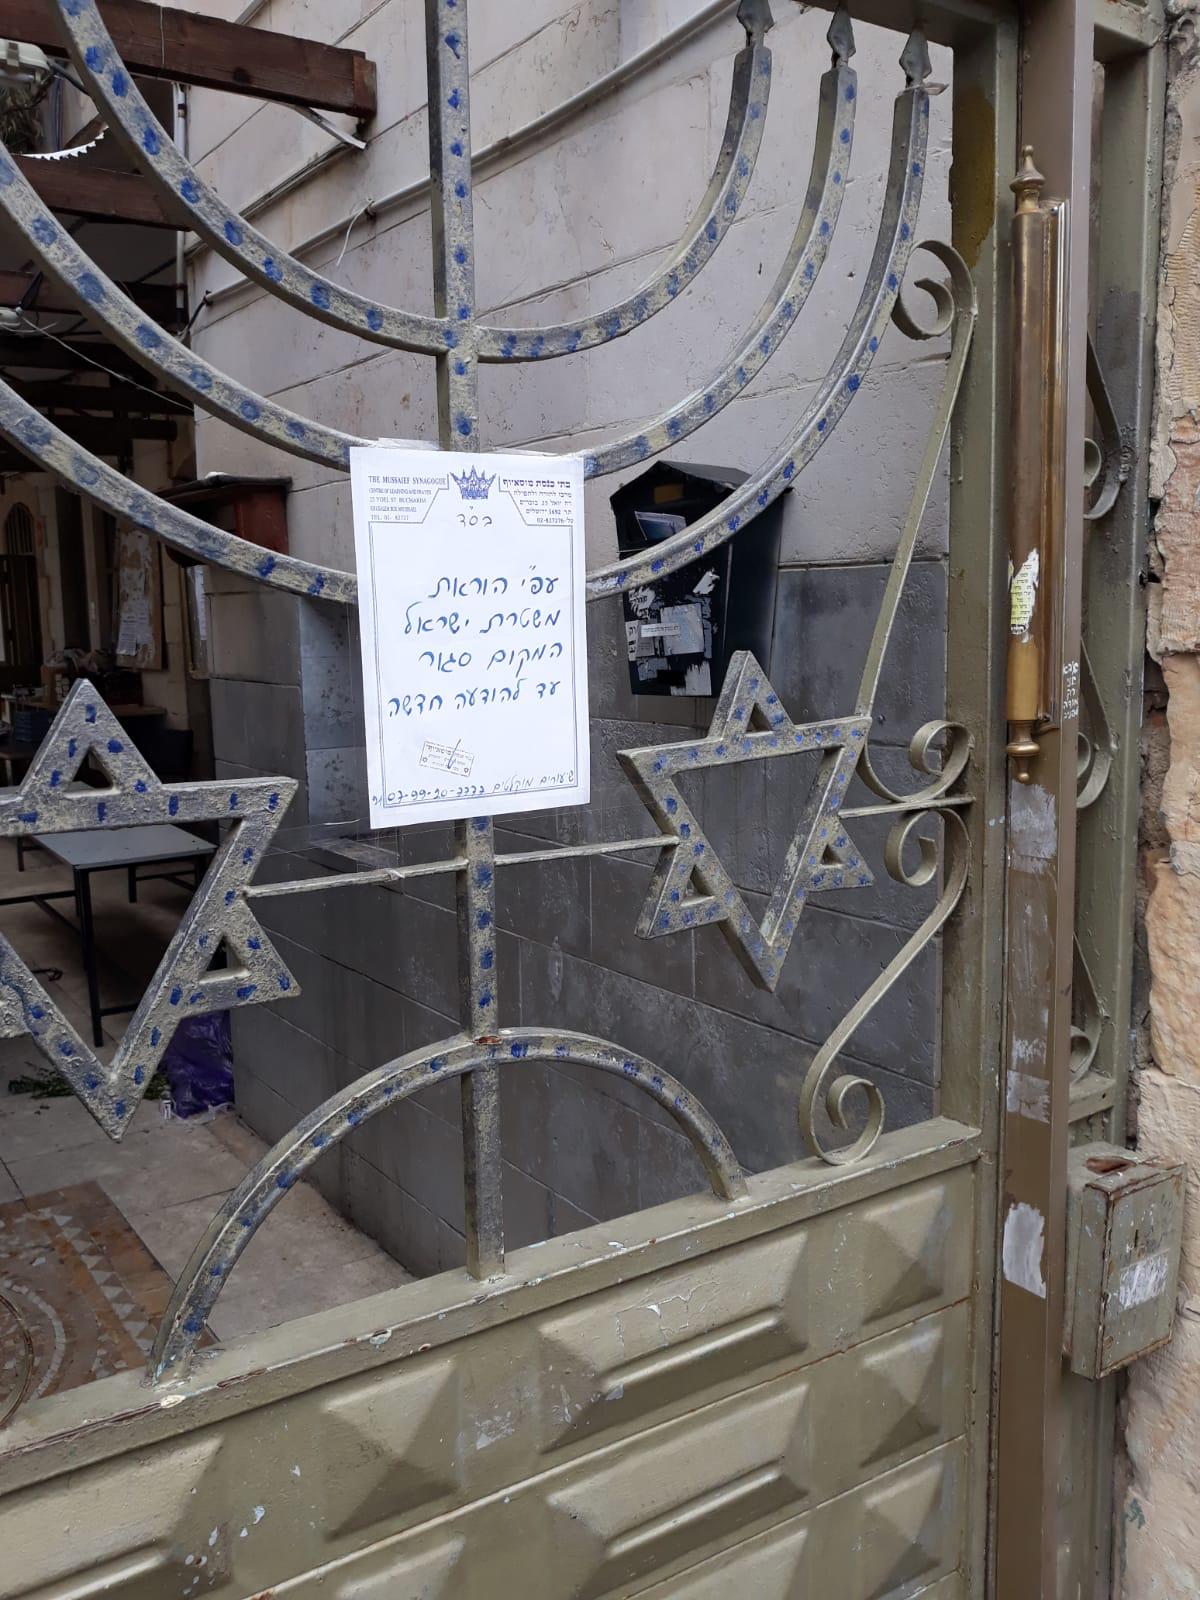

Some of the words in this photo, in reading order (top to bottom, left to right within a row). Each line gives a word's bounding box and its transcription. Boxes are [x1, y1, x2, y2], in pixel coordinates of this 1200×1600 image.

[367, 475, 380, 484] THE
[412, 476, 447, 486] SYNAGOGUE
[535, 479, 555, 488] כנסת
[557, 480, 571, 489] בתי
[428, 577, 508, 598] הוראת
[404, 601, 470, 635] ישראל
[479, 607, 561, 634] משטרת
[418, 650, 472, 673] סגור
[487, 642, 563, 678] המקום
[454, 678, 528, 710] להודעה
[535, 680, 561, 699] עד
[387, 693, 443, 718] חדשה
